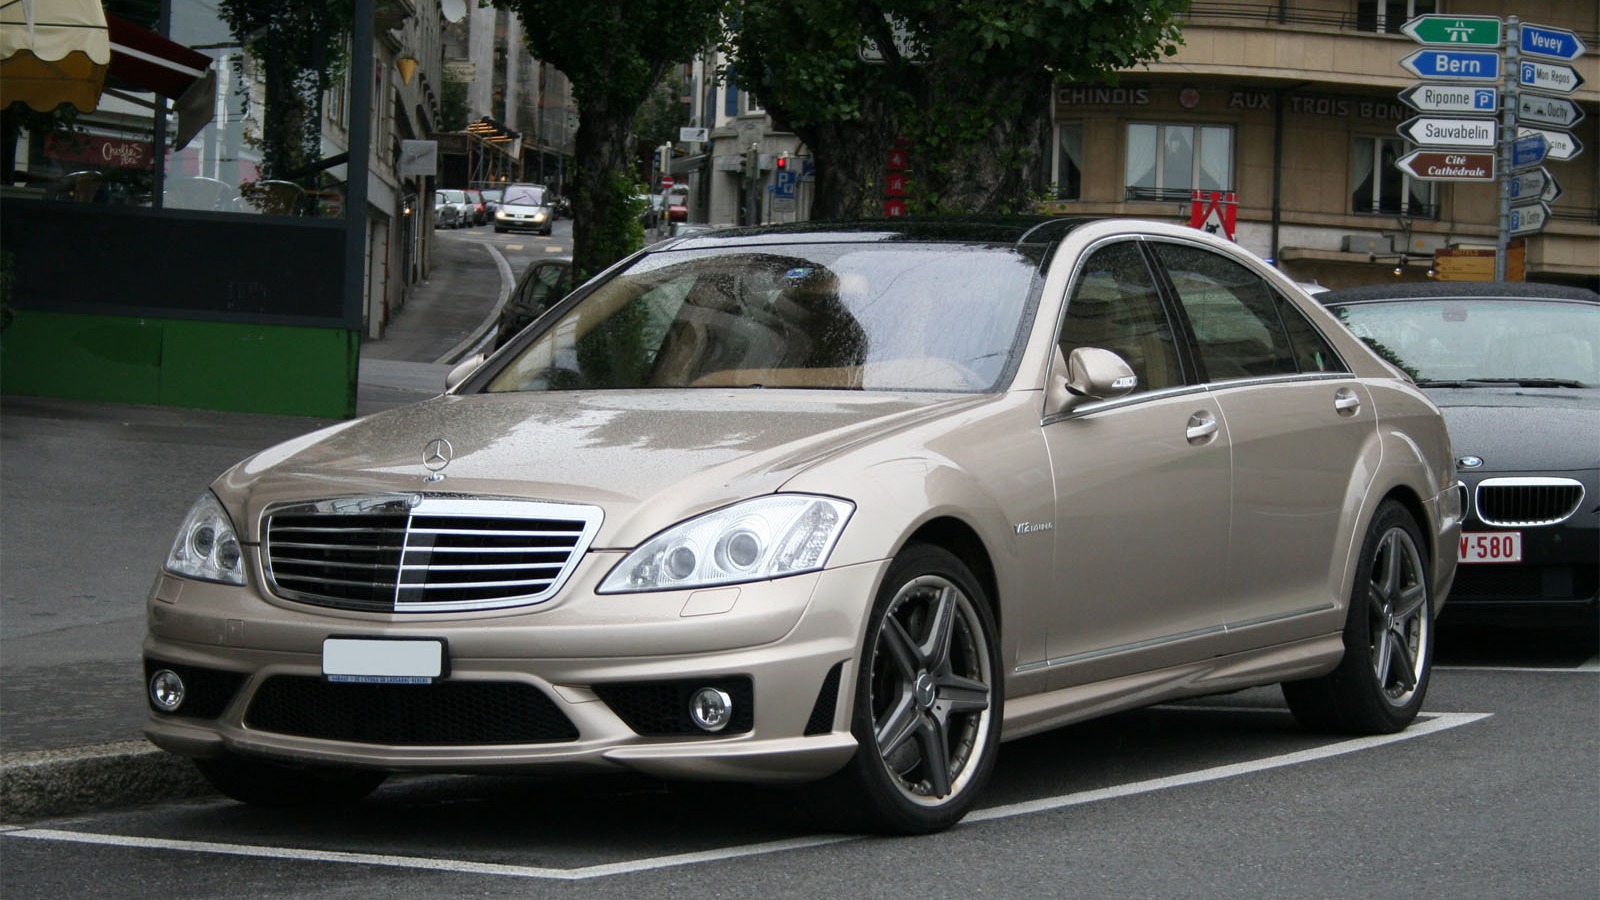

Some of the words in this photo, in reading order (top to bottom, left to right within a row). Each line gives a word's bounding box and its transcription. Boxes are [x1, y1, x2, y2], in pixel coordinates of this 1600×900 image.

[1530, 31, 1563, 54] Vevey
[1435, 54, 1481, 73] Bern
[1536, 68, 1549, 80] Mon
[1551, 70, 1570, 85] Repos
[1229, 92, 1272, 110] AUX
[1291, 97, 1350, 116] TROIS
[1359, 102, 1413, 120] BON
[1425, 89, 1470, 107] Riponne
[1547, 102, 1568, 122] Ouchy
[1425, 123, 1489, 139] Sauvabelin
[1445, 155, 1467, 165] Cité
[1427, 165, 1485, 177] Cathédrale
[778, 173, 788, 188] P
